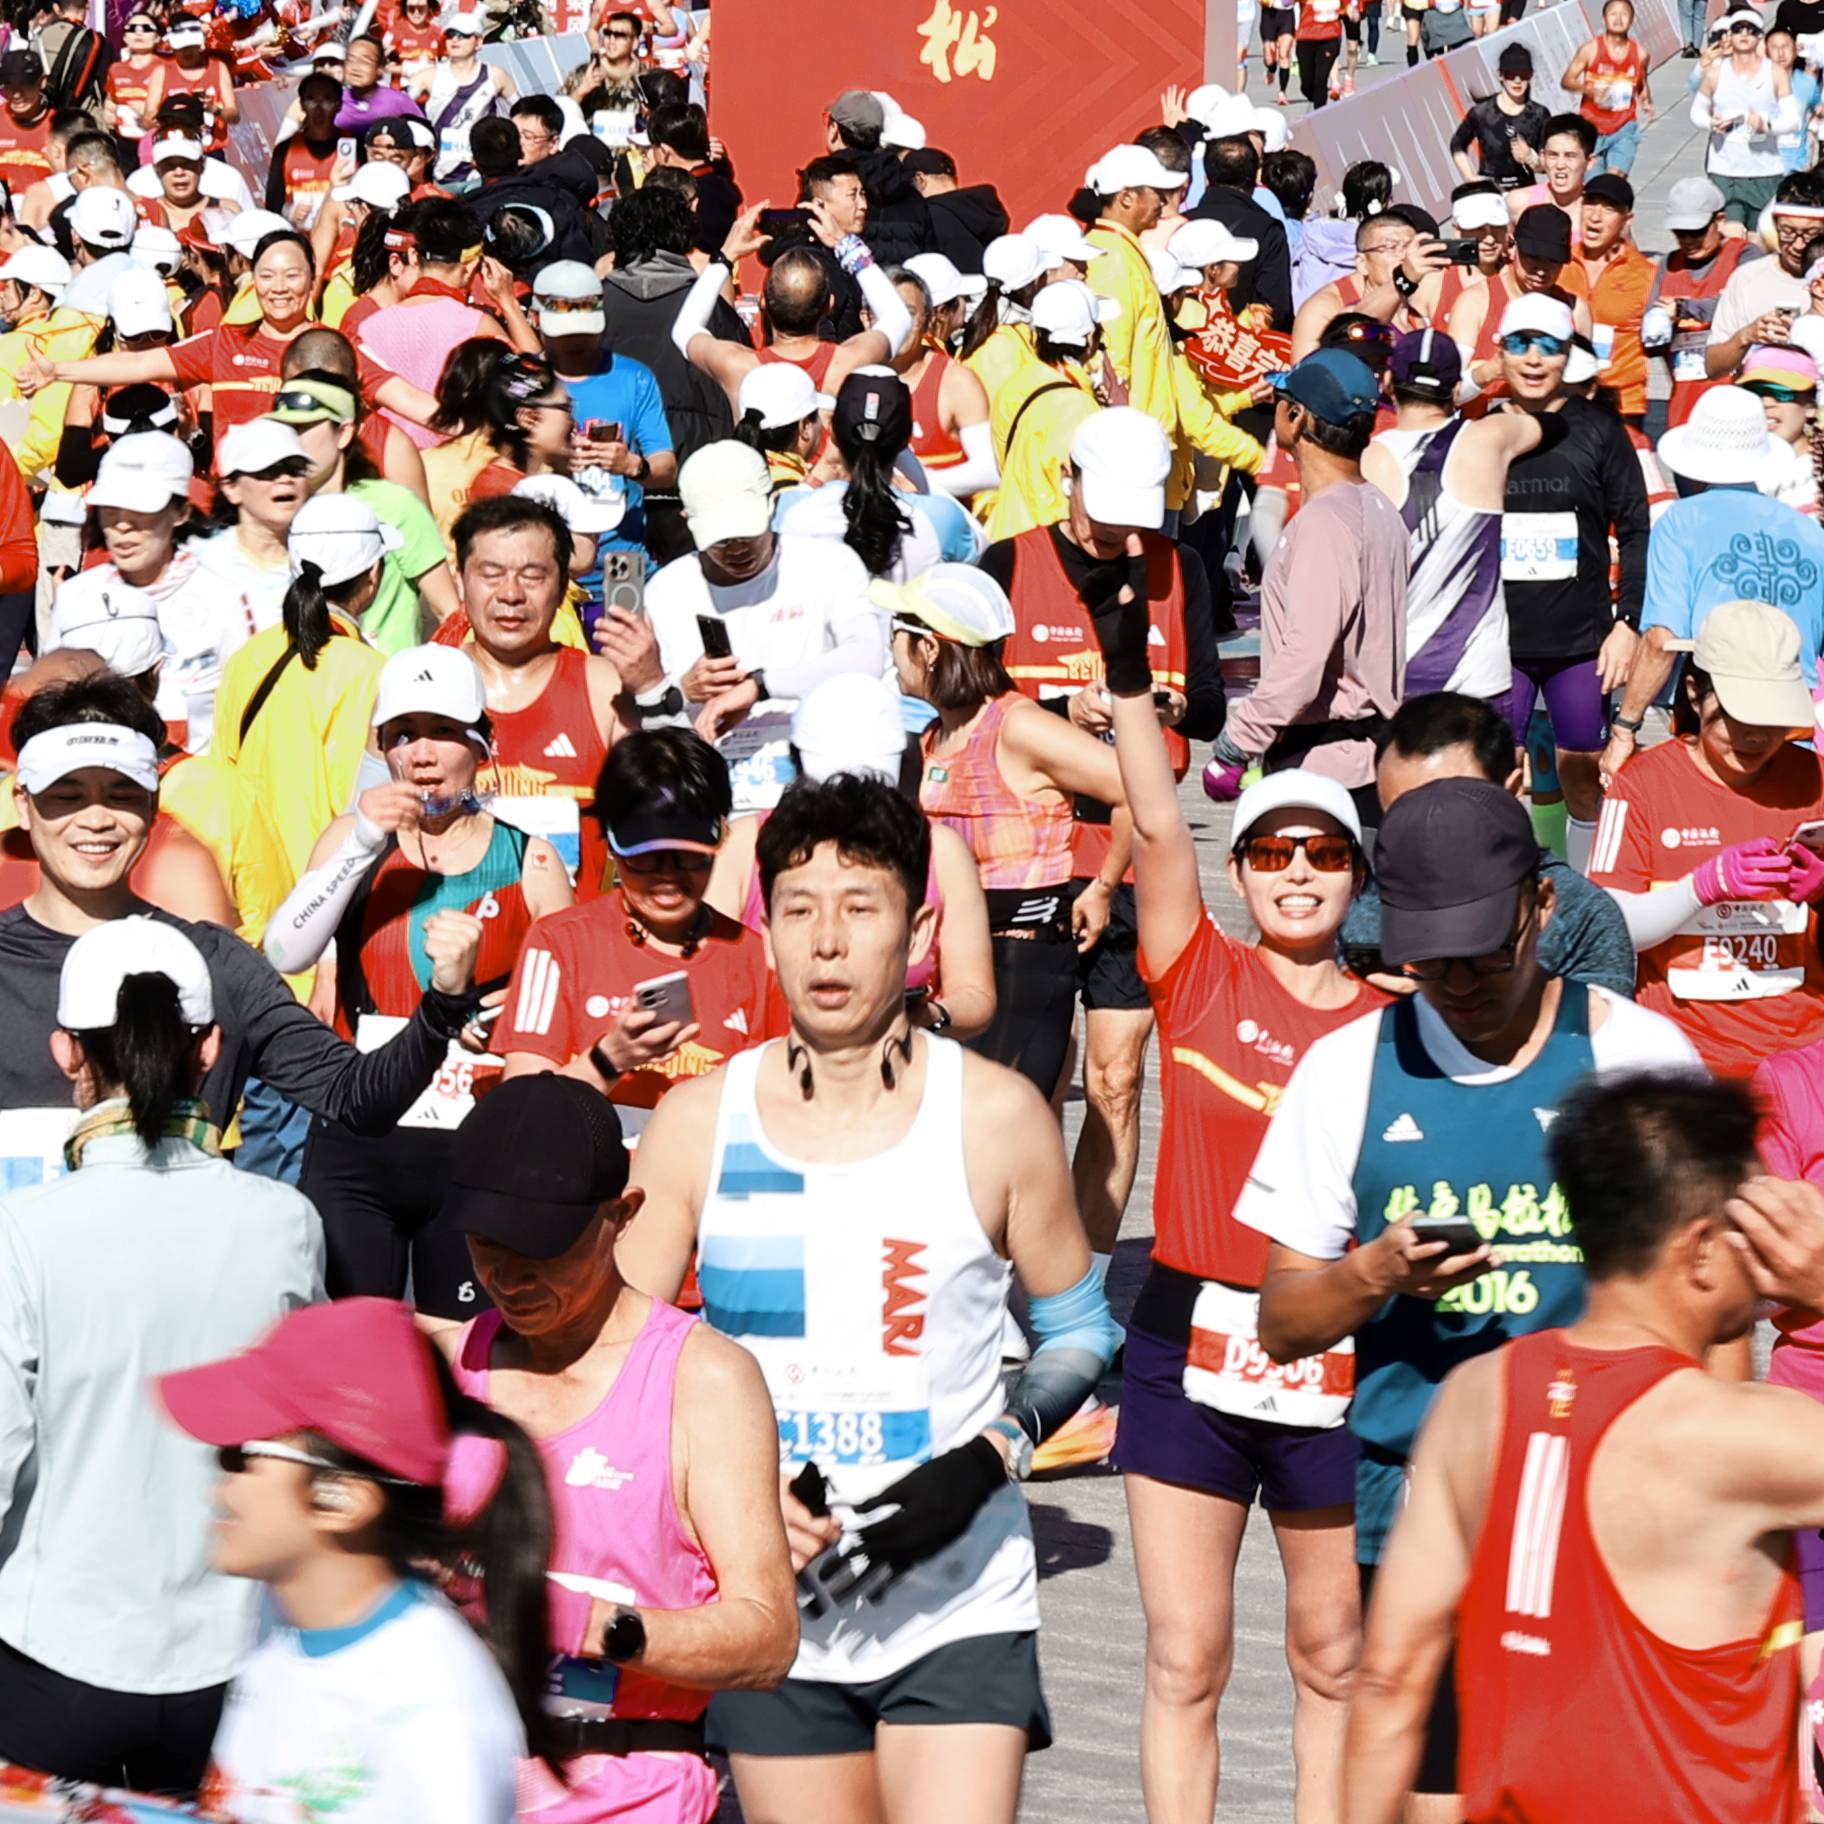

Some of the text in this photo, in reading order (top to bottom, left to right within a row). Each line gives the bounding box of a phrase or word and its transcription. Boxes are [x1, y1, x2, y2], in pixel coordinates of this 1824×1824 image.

[1505, 539, 1557, 561] E0659
[292, 857, 358, 931] CHINA SPEED
[1704, 934, 1778, 966] E9240
